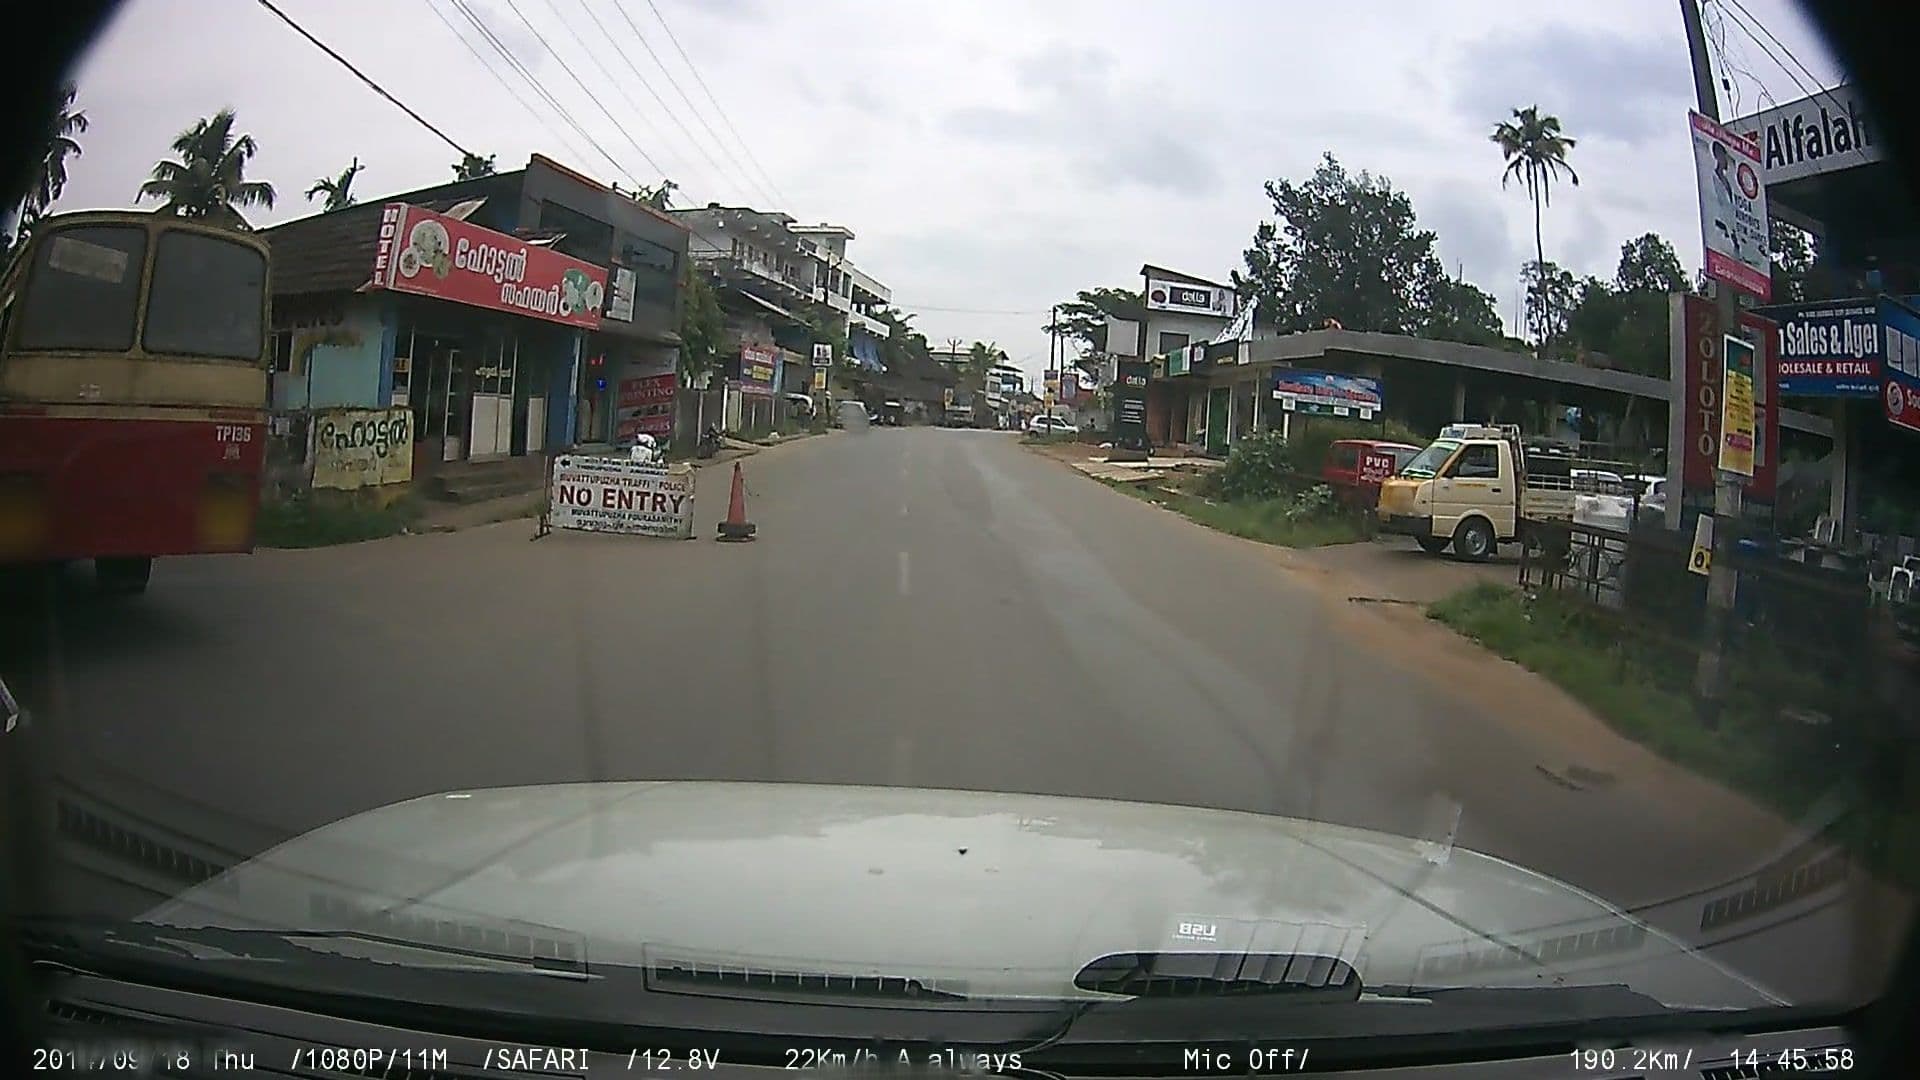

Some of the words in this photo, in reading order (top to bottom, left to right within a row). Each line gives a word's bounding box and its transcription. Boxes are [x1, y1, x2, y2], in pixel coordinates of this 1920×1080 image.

[374, 208, 399, 286] HOTEL
[1786, 321, 1828, 356] Sales
[1830, 324, 1841, 354] &
[1836, 362, 1871, 375] RETAIL
[559, 485, 592, 506] NO
[602, 487, 684, 514] ENTRY
[658, 480, 686, 492] POLICE
